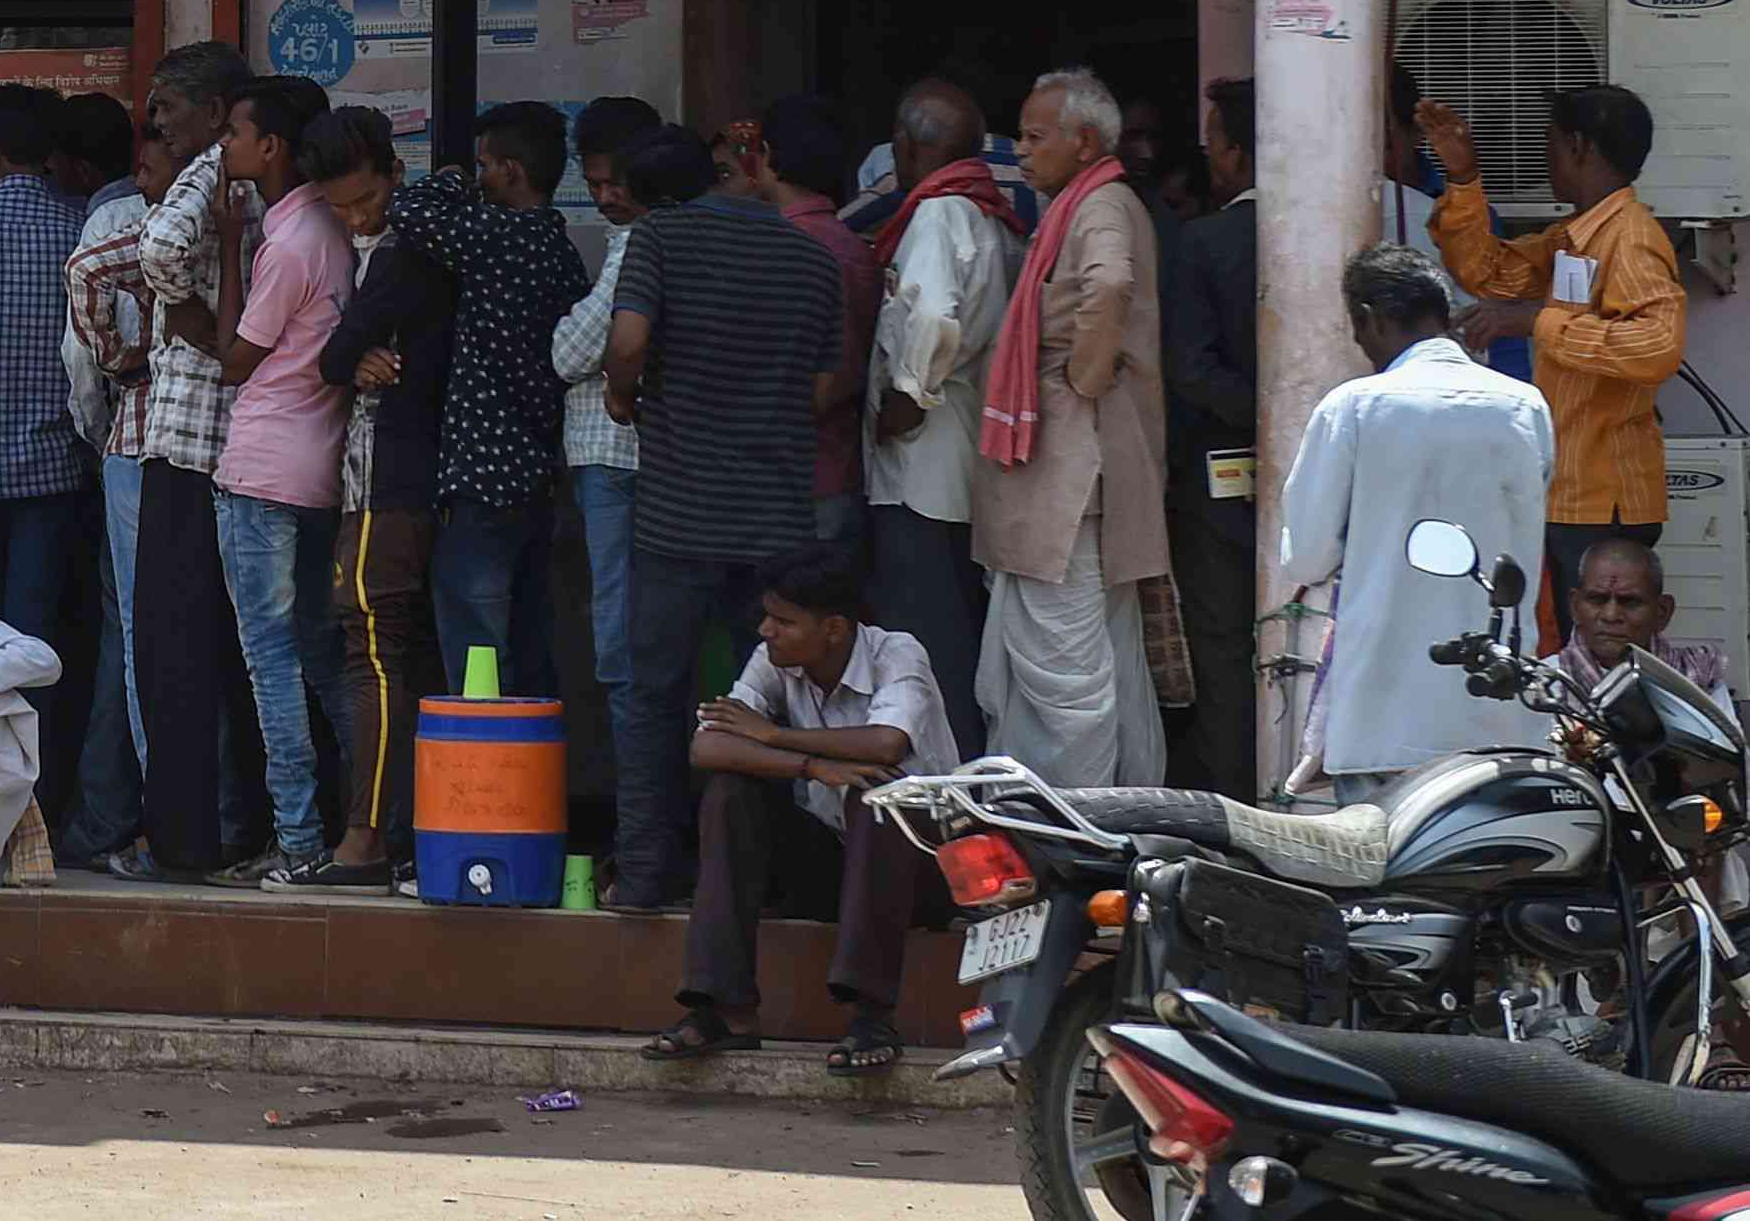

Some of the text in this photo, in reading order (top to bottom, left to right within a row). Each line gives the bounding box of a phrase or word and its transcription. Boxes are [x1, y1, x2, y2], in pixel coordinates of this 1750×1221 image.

[280, 36, 338, 64] 46/1
[989, 908, 1030, 941] GJ22
[1370, 1142, 1551, 1184] Shine
